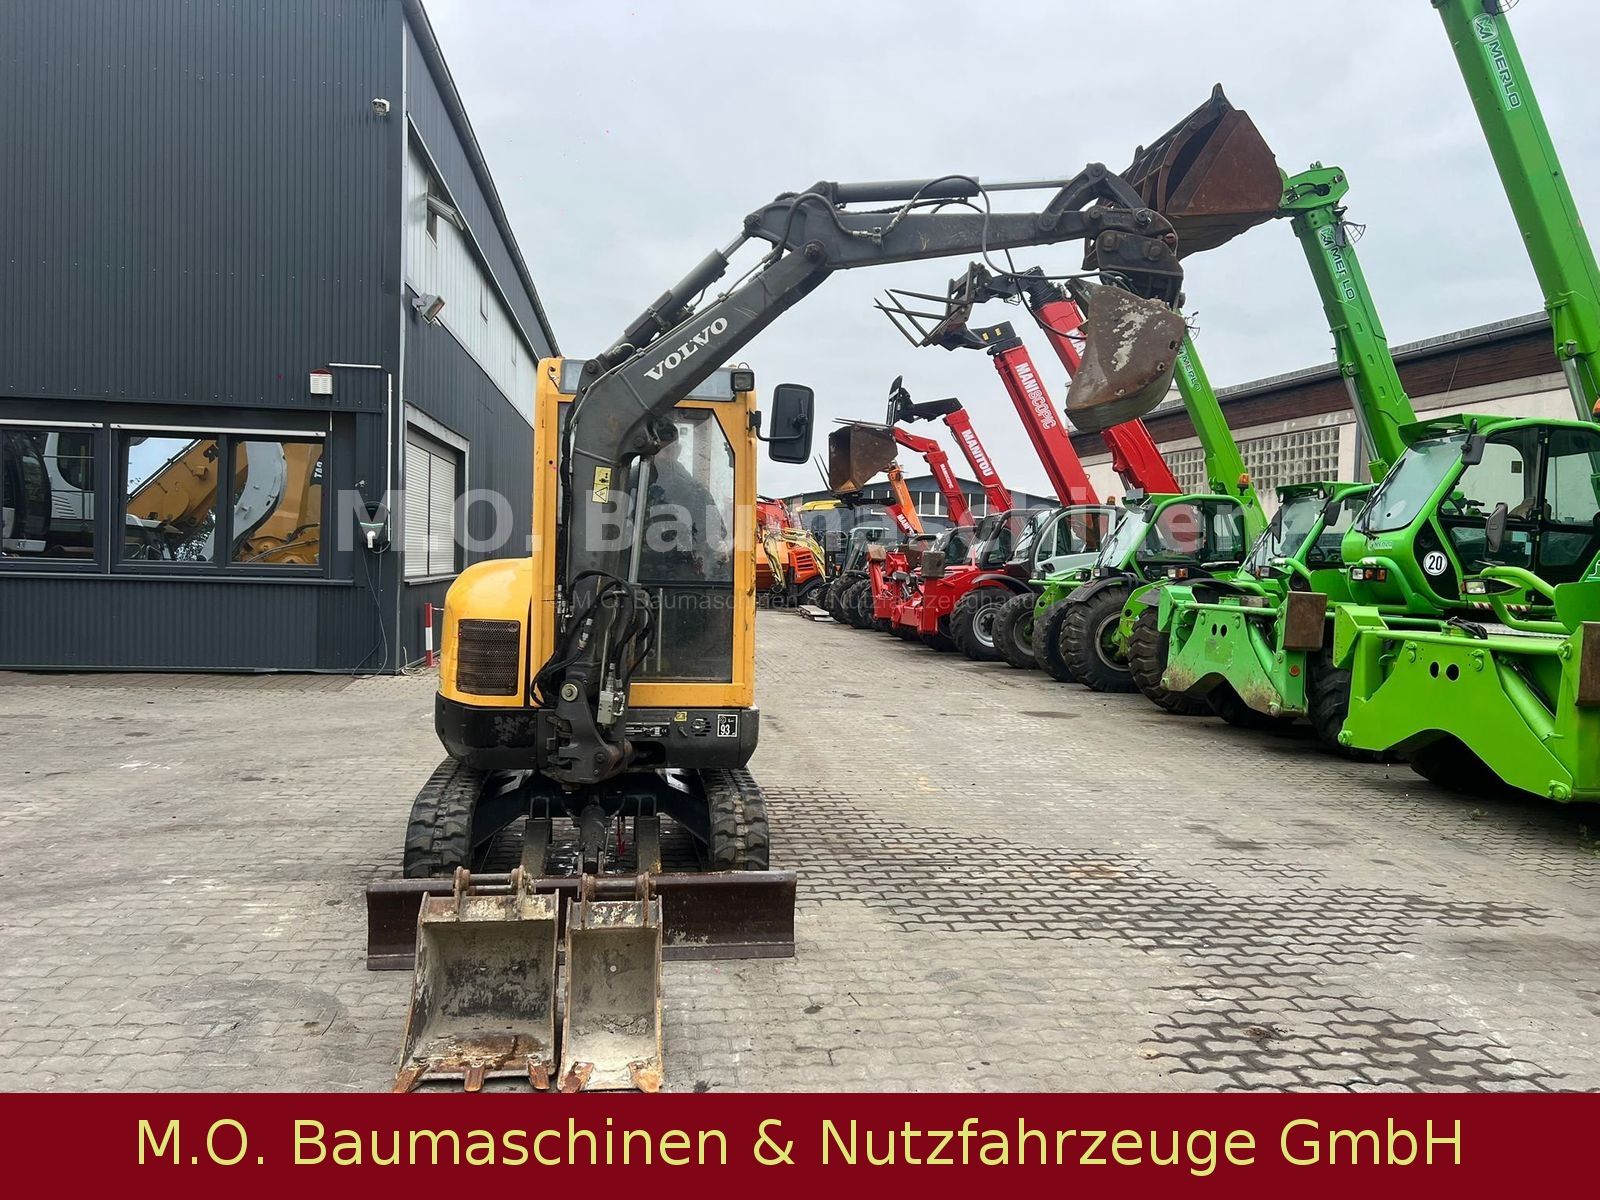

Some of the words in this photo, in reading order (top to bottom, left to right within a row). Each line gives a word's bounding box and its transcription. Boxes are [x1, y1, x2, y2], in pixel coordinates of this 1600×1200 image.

[1488, 40, 1522, 108] MERLO
[643, 317, 728, 381] VOLVO
[1066, 327, 1088, 360] MA
[1181, 354, 1201, 392] MERLO
[1014, 361, 1058, 430] MANISCOPIC
[961, 428, 995, 477] MANITOU
[1428, 555, 1443, 571] 20
[720, 724, 730, 735] 93
